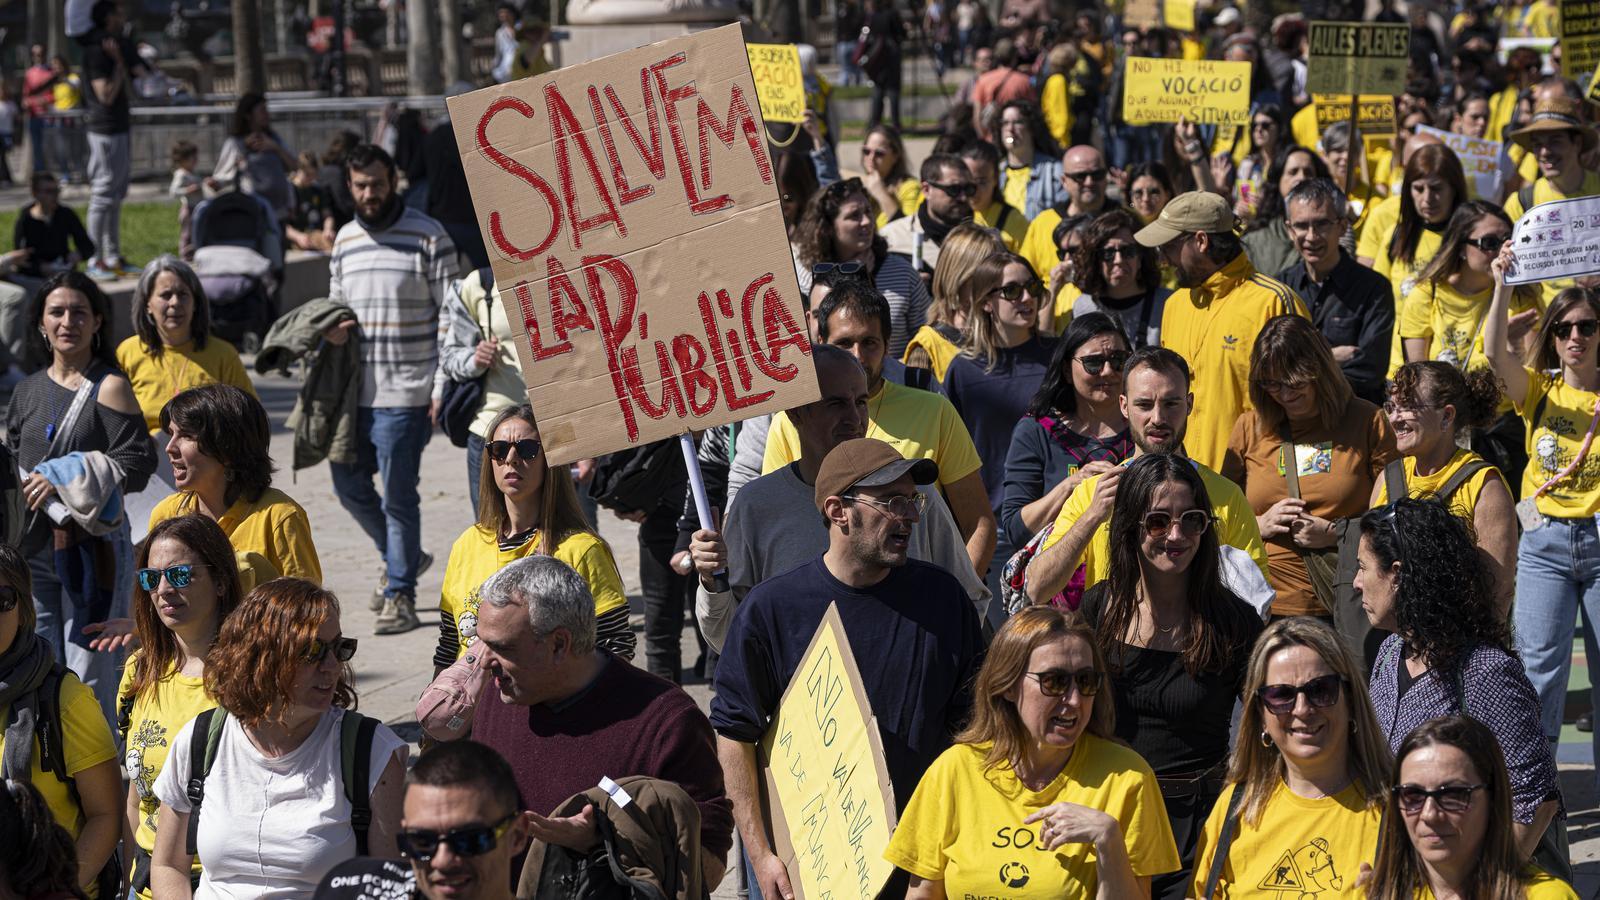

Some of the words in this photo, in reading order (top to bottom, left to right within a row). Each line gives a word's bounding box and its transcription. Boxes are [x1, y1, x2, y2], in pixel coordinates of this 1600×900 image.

[1312, 26, 1356, 55] AULES
[1358, 27, 1408, 56] PLENES
[1133, 62, 1152, 73] NO
[1164, 62, 1182, 73] HI
[1198, 62, 1215, 73] HA
[1161, 74, 1243, 95] VOCACIÓ
[1128, 95, 1147, 106] QUE
[474, 51, 774, 264] SALVEM
[1573, 220, 1585, 229] 20
[1517, 252, 1537, 261] VOLEU
[1524, 260, 1555, 270] RECURSOS
[1560, 256, 1587, 266] REALITAT
[513, 255, 595, 362] LA
[780, 718, 792, 758] VA
[330, 875, 361, 889] ONE
